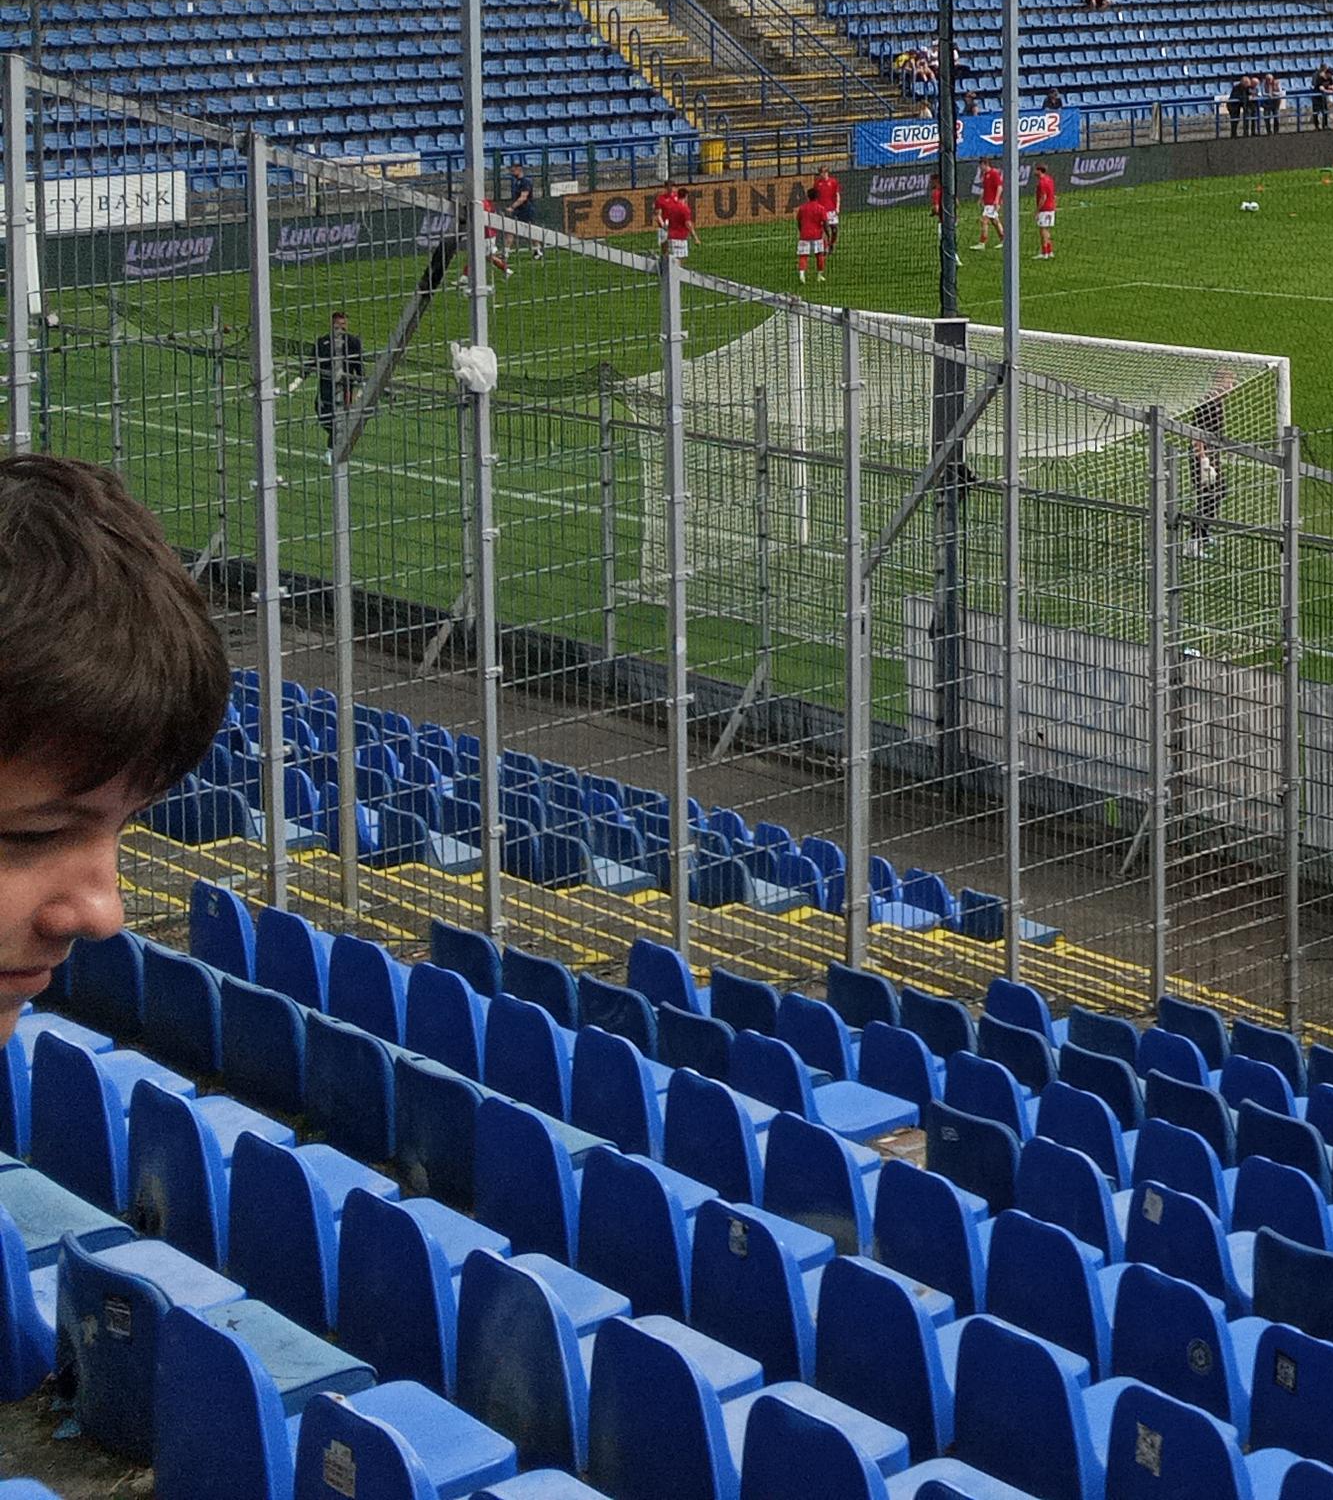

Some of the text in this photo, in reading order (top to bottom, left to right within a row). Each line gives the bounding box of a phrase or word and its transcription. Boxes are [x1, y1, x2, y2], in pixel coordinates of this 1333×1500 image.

[1073, 155, 1127, 175] LUKROM
[98, 190, 171, 211] BANK
[567, 180, 810, 233] FOTUNA
[278, 221, 361, 248] LUKROM
[126, 235, 214, 262] LUKROM
